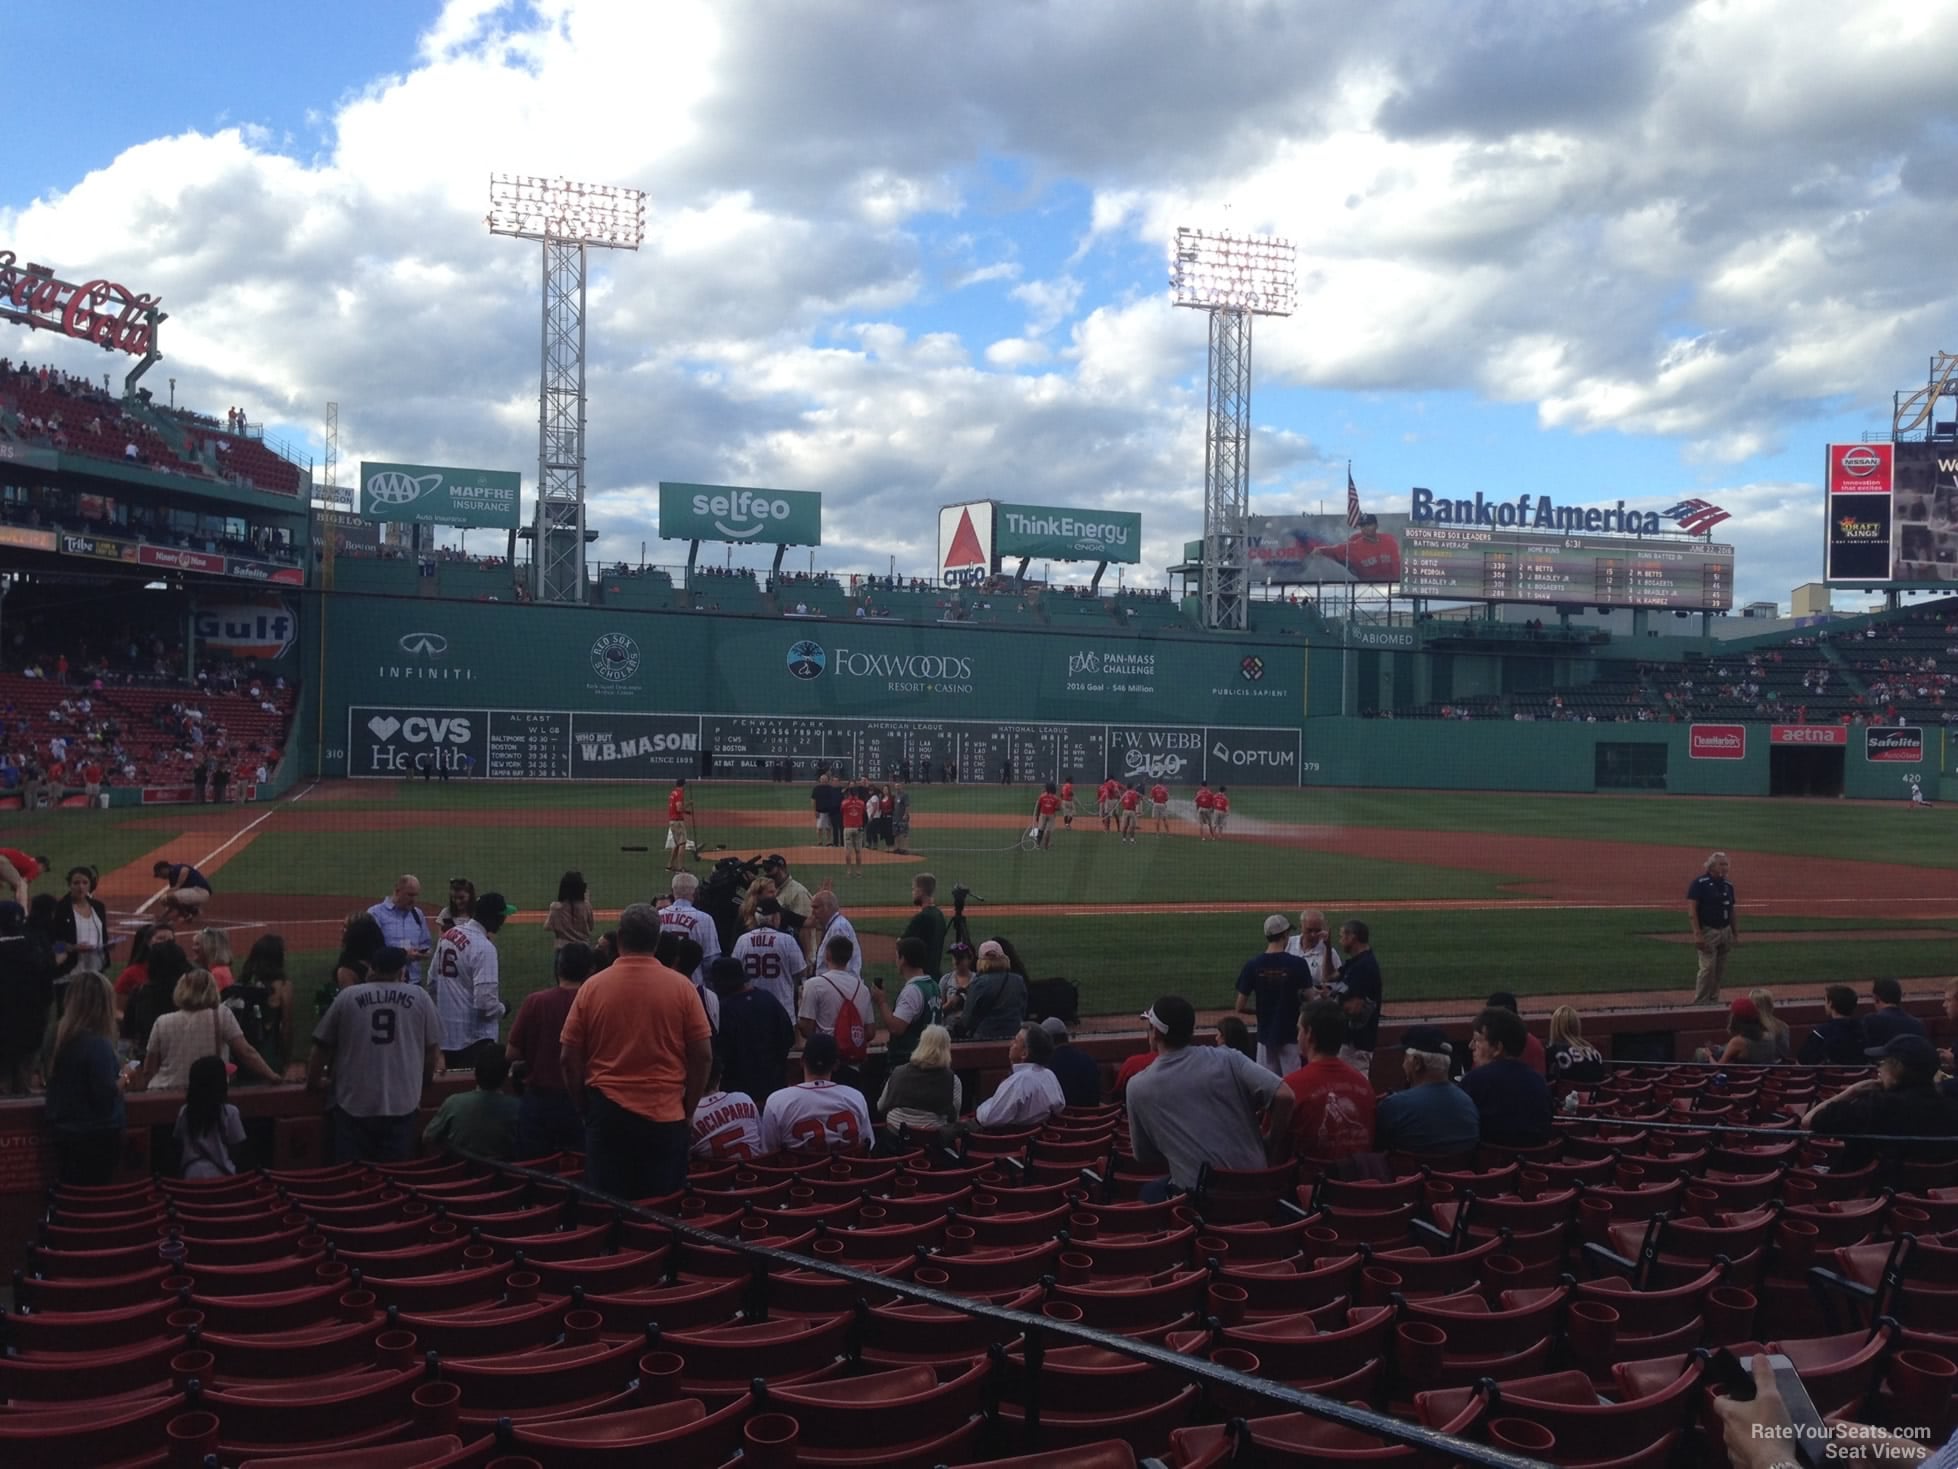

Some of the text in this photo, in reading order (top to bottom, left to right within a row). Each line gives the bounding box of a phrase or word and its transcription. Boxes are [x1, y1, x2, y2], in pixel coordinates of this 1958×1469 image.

[1844, 458, 1879, 466] NISSAN
[375, 473, 414, 501] AAA
[449, 485, 514, 500] MAPFRE
[453, 500, 511, 512] INSURANCE
[415, 513, 467, 523] Auto Insurance
[1845, 523, 1879, 531] DRAFT
[1405, 529, 1492, 541] BOSTON RED SOX LEADERS
[64, 535, 94, 554] Tribe
[345, 541, 377, 552] Boston
[1413, 540, 1469, 550] BATTING AVERAGE
[233, 565, 269, 579] Safelite
[1420, 568, 1445, 576] PEDROIA
[1535, 565, 1554, 573] BETTS
[1644, 570, 1663, 578] BETTS
[1420, 578, 1447, 586] BRADLEY
[1534, 574, 1561, 582] BRADLEY
[1606, 577, 1613, 585] 12
[1644, 579, 1674, 587] BOGAERTS
[1420, 587, 1439, 595] BETTS
[1534, 584, 1565, 592] BOGAERTS
[1644, 588, 1670, 596] BRADLEY
[1644, 598, 1669, 606] RAMIREZ
[195, 613, 291, 641] Gulf
[1361, 633, 1413, 646] ABIOMED
[593, 634, 632, 656] RED SOX
[594, 653, 639, 681] SCHOLARS
[1103, 665, 1155, 676] CHALLENGE
[379, 666, 472, 681] INFINITI
[888, 682, 973, 694] RESORT CASINO
[1066, 682, 1085, 691] 2016
[1086, 682, 1104, 692] Goal
[1128, 684, 1154, 694] Million
[732, 719, 825, 728] FENWAY PARK
[867, 723, 944, 732] AMERICAN LEAGUE
[402, 716, 472, 744] CVS
[998, 726, 1036, 734] NATIONAL
[1781, 727, 1835, 743] aetna
[491, 735, 526, 743] BALTIMORE
[575, 733, 613, 743] WHO BUT
[1111, 731, 1201, 749] F.W. WEBB
[1868, 737, 1921, 749] Safelite
[325, 749, 344, 760] 310
[491, 752, 522, 760] TORONTO
[1232, 750, 1295, 767] OPTUM
[1883, 750, 1921, 760] AutoGlass
[649, 756, 674, 764] SINCE
[1901, 773, 1921, 783] 420
[354, 989, 415, 1010] WILLIAMS
[370, 1008, 396, 1045] 9
